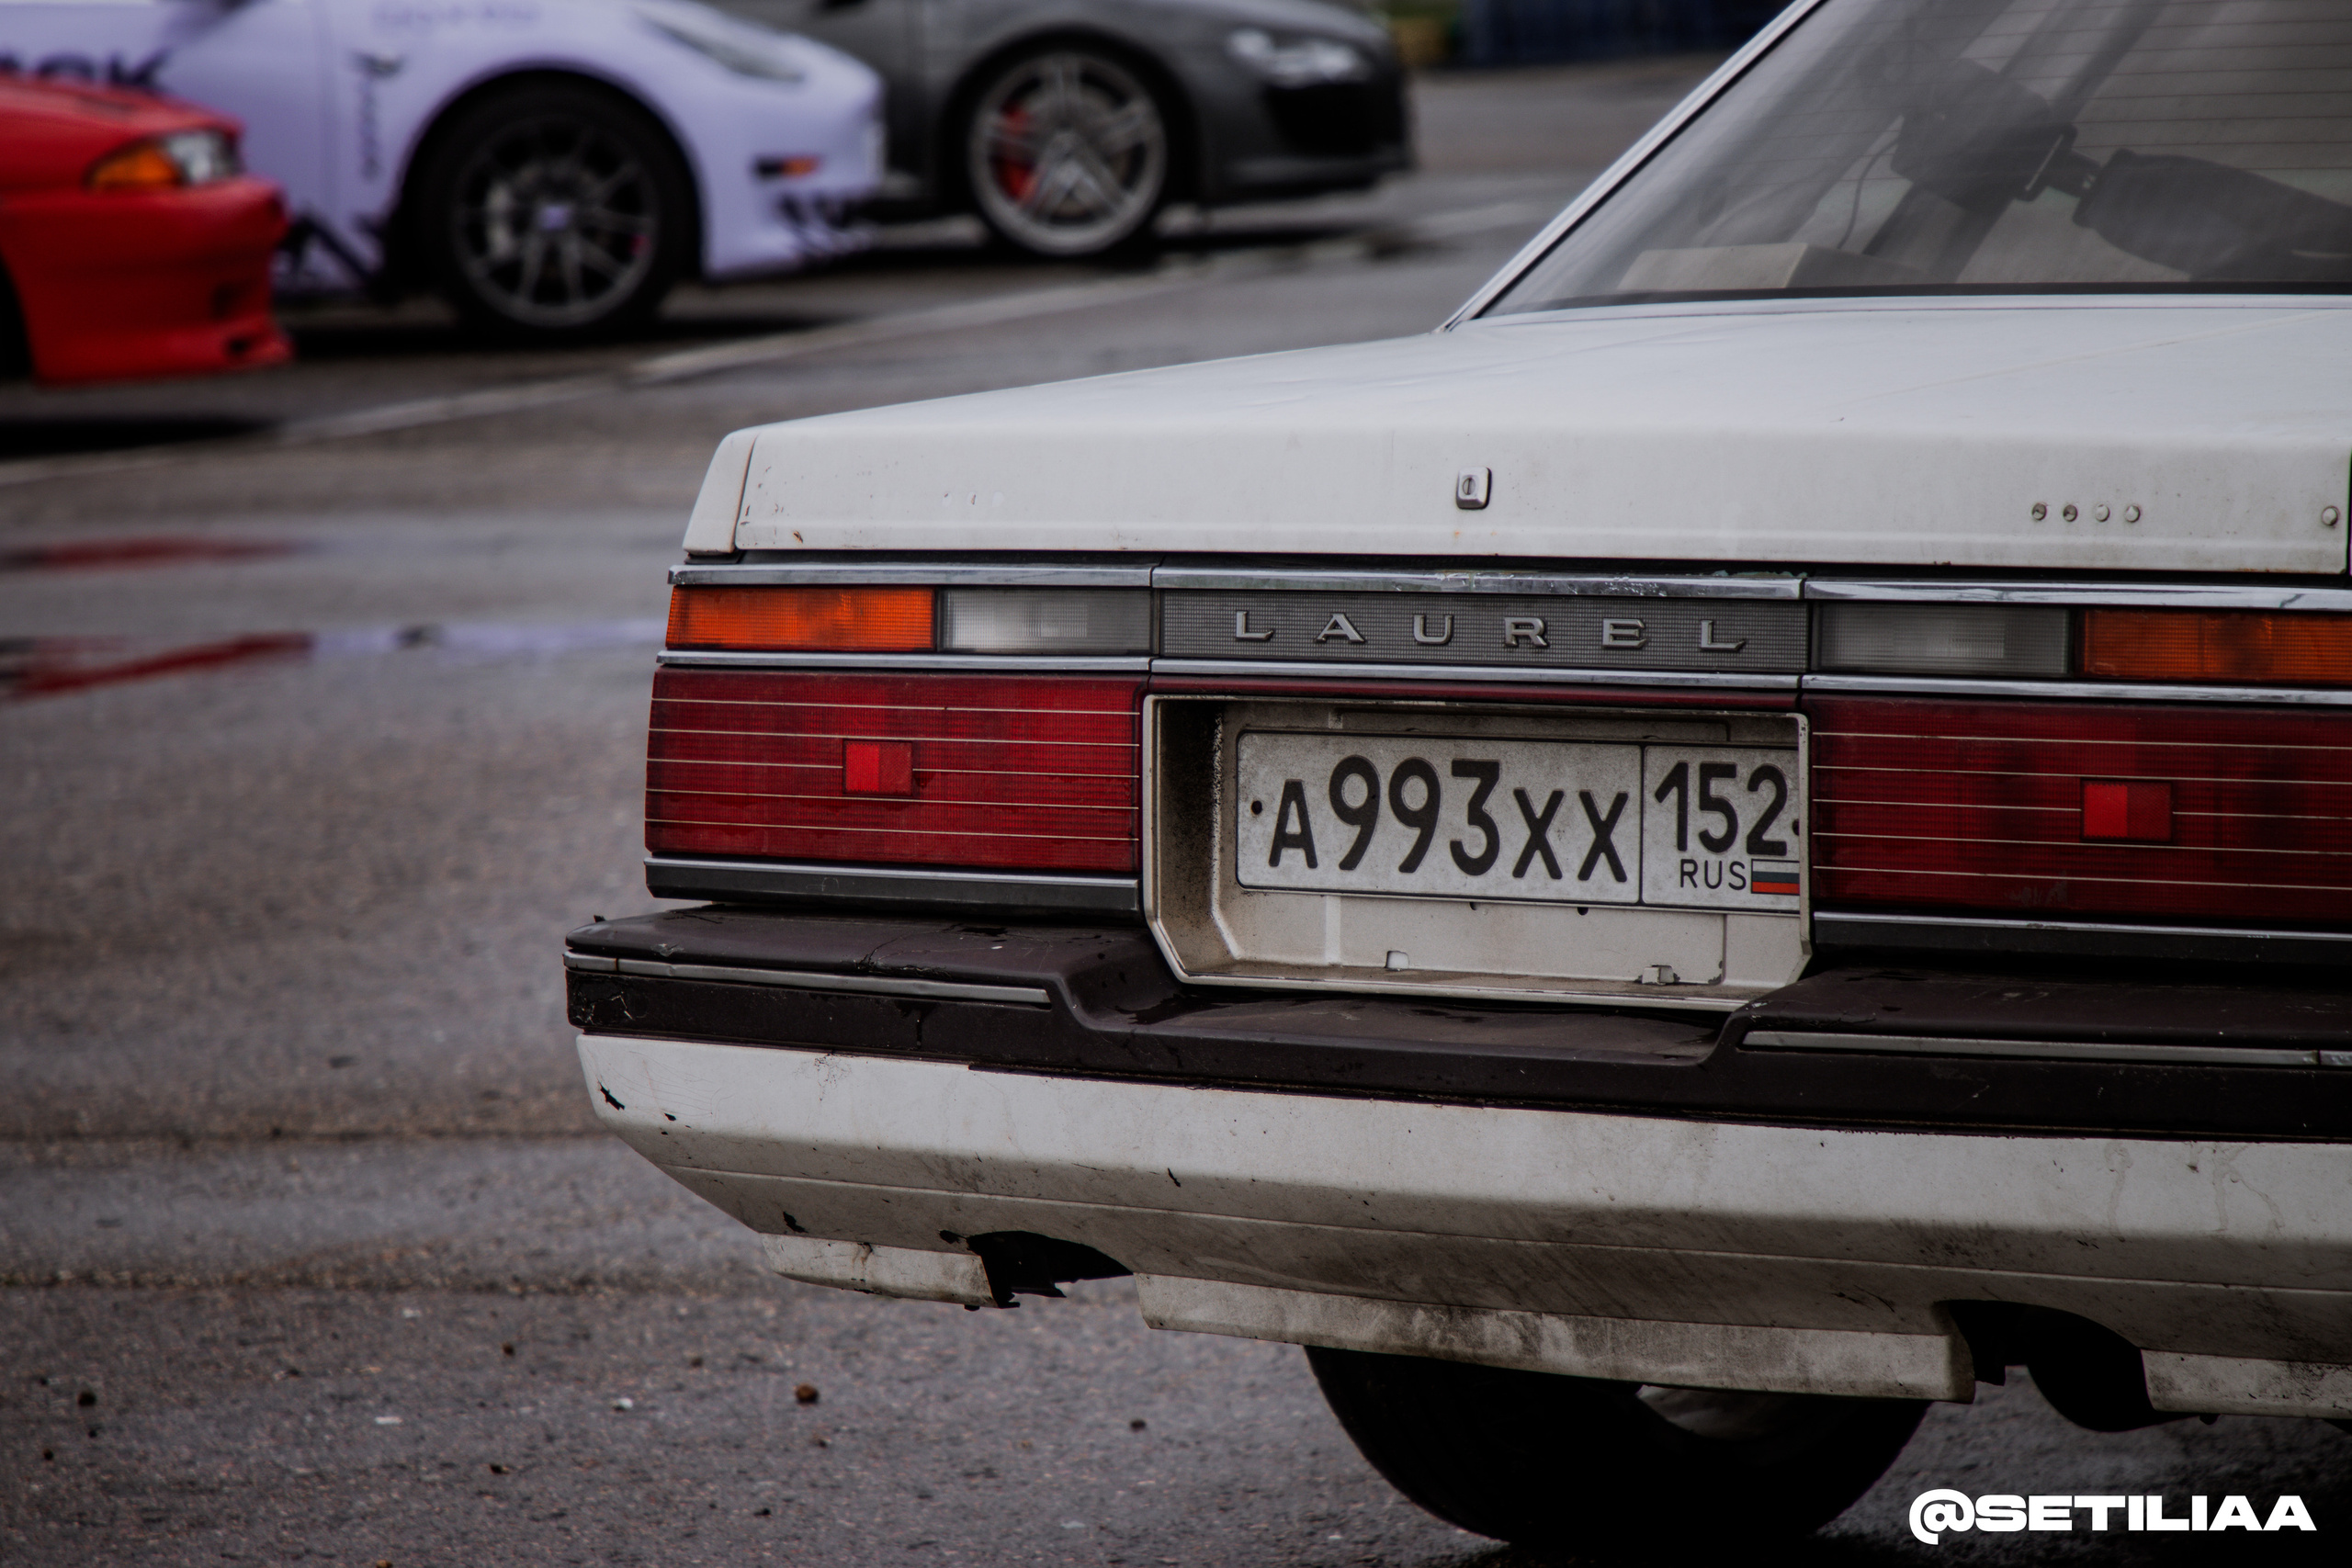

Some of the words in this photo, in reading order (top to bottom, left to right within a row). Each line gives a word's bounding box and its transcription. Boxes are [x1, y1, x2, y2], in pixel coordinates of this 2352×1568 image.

[1235, 610, 1745, 652] LAUREL
[1268, 754, 1629, 884] A993XX
[1654, 761, 1790, 856] 152
[1679, 859, 1747, 890] RUS
